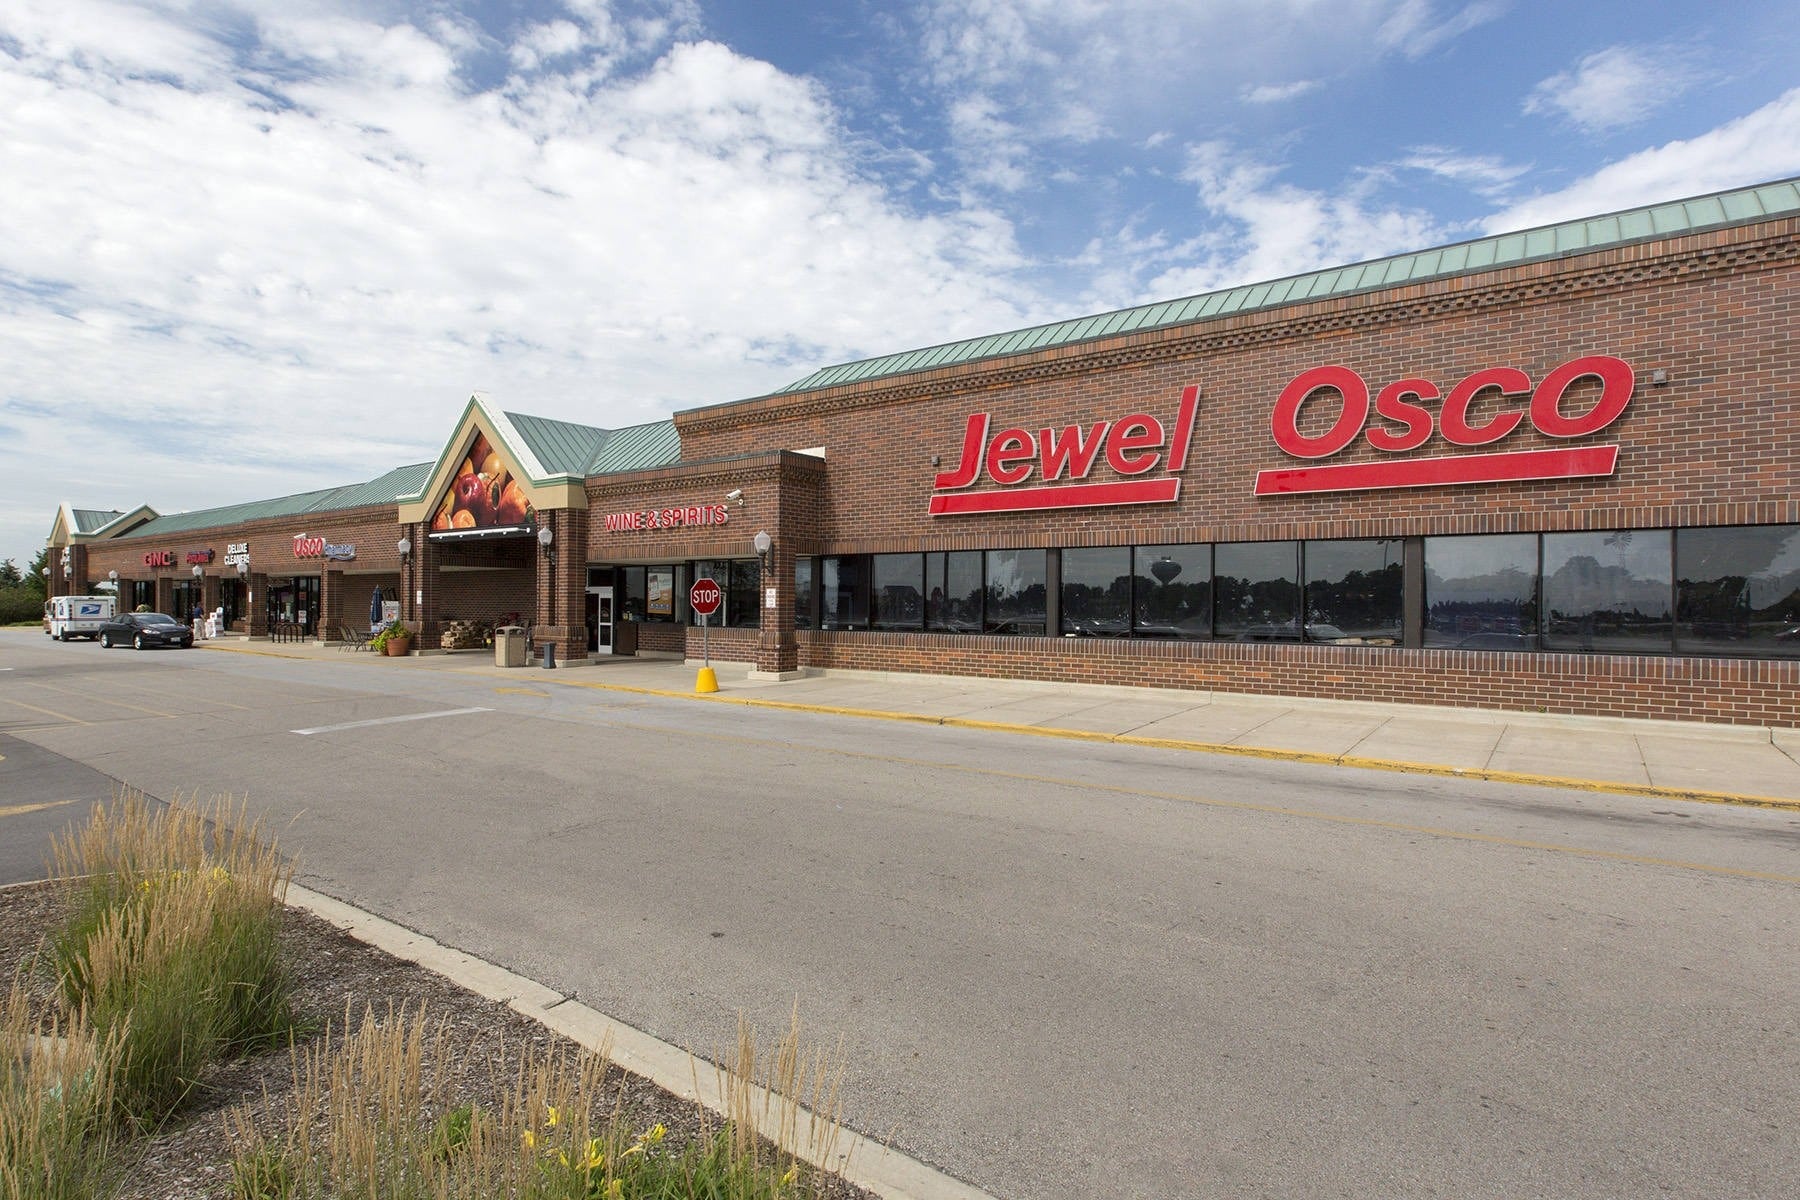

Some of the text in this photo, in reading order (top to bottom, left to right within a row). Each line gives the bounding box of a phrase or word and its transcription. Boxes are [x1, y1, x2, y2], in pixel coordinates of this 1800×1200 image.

[934, 356, 1634, 490] Jewel Osco
[604, 506, 728, 531] WINE & SPIRITS
[228, 543, 248, 554] DELUXE
[143, 551, 171, 566] GNC
[224, 554, 250, 565] CLEANERS
[693, 590, 718, 604] STOP
